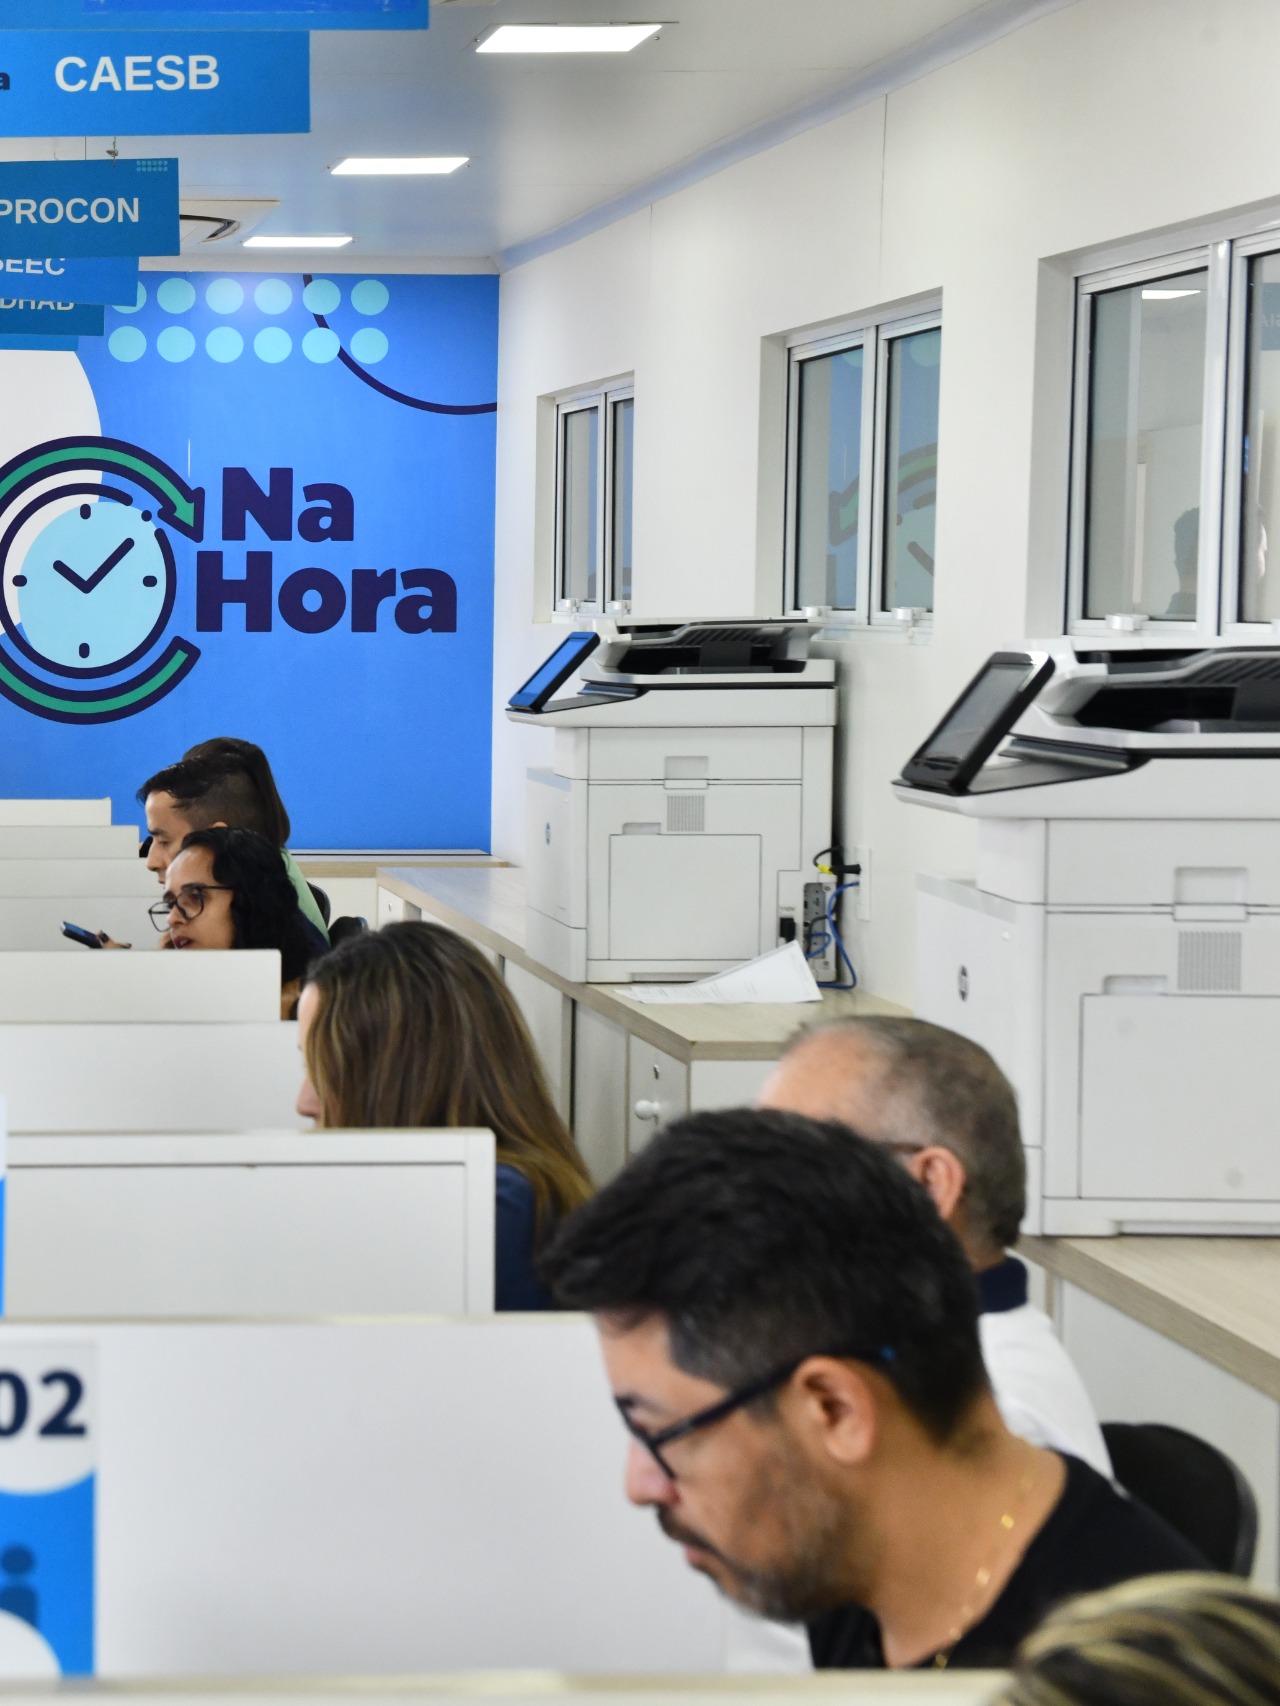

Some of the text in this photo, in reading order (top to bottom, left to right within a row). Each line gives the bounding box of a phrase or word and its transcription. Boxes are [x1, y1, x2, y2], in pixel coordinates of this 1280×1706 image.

[54, 54, 220, 92] CAESB
[221, 467, 355, 542] Na
[196, 551, 458, 634] Hora
